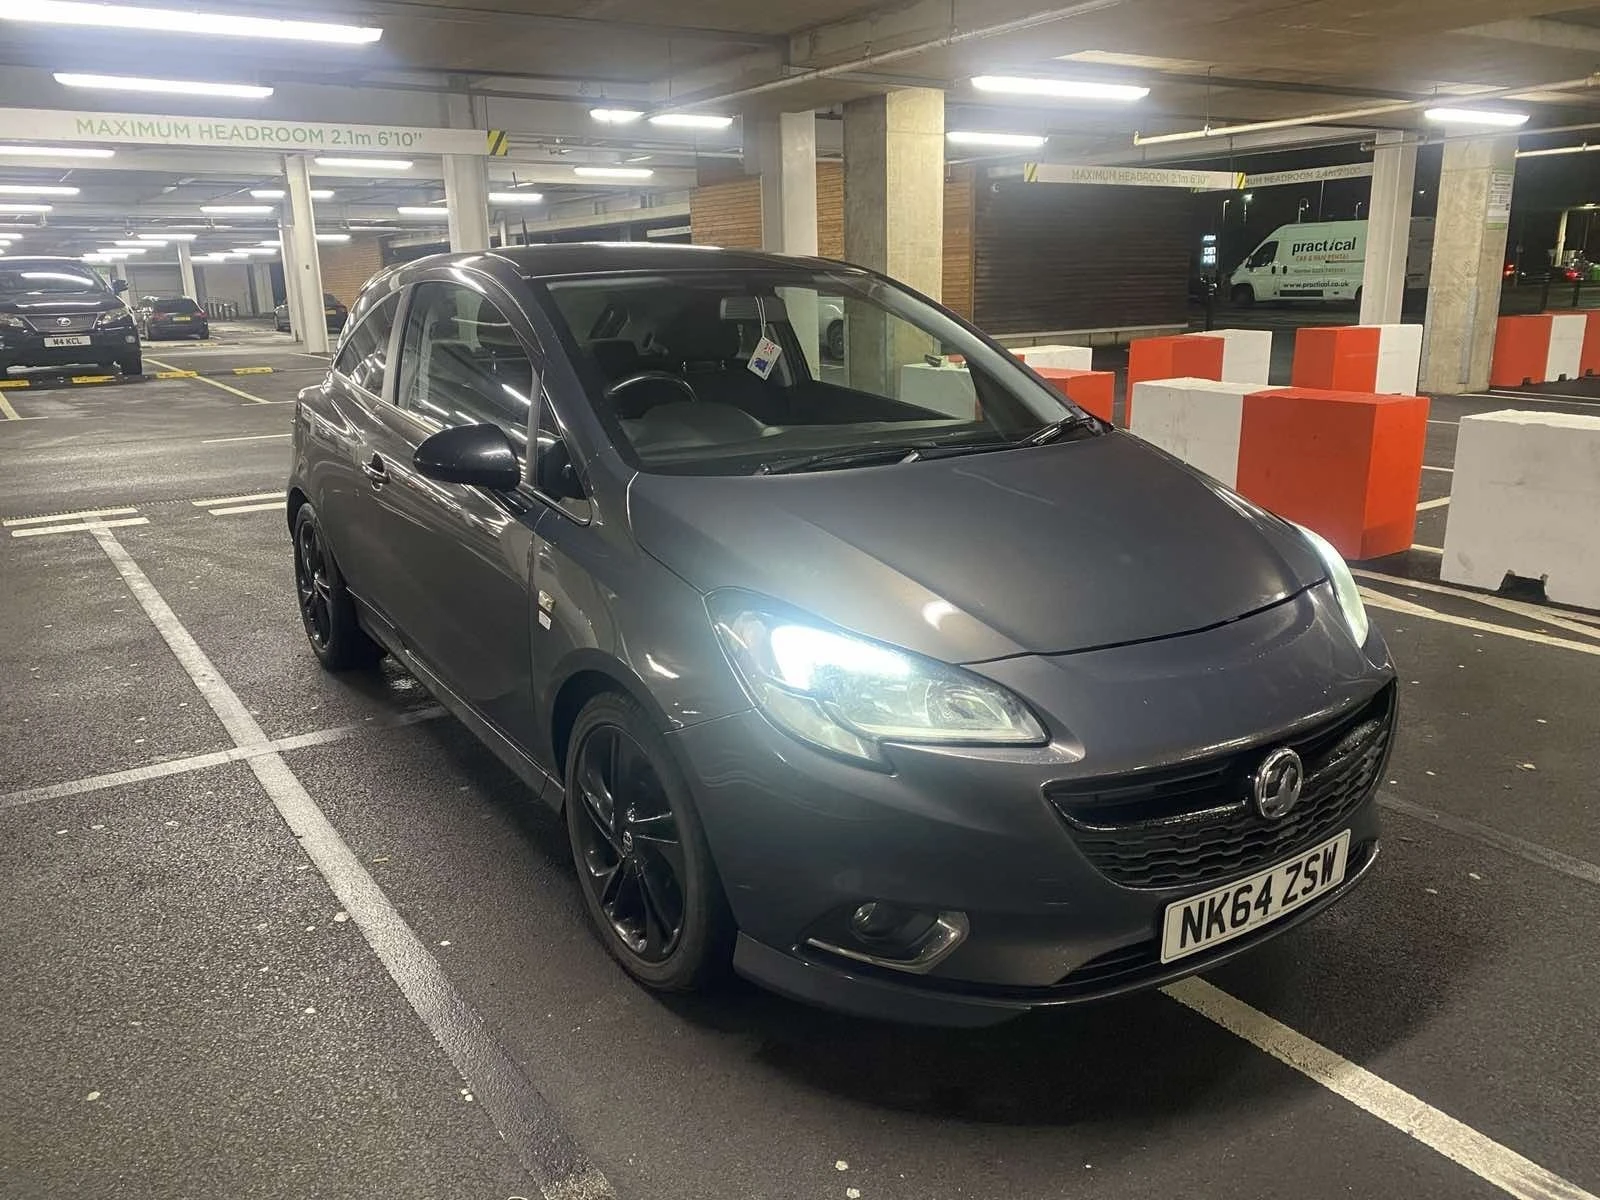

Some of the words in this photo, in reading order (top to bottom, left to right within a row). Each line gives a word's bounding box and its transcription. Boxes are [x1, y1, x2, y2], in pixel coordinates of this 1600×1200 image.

[75, 118, 190, 138] MAXIMUM
[197, 125, 323, 143] HEADROOM
[331, 129, 371, 145] 2.1m
[1072, 168, 1116, 181] MAXIMUM
[1118, 171, 1169, 183] HEADROOM
[1291, 237, 1357, 256] practical
[1179, 875, 1273, 949] NK64
[1281, 841, 1338, 907] ZSW
